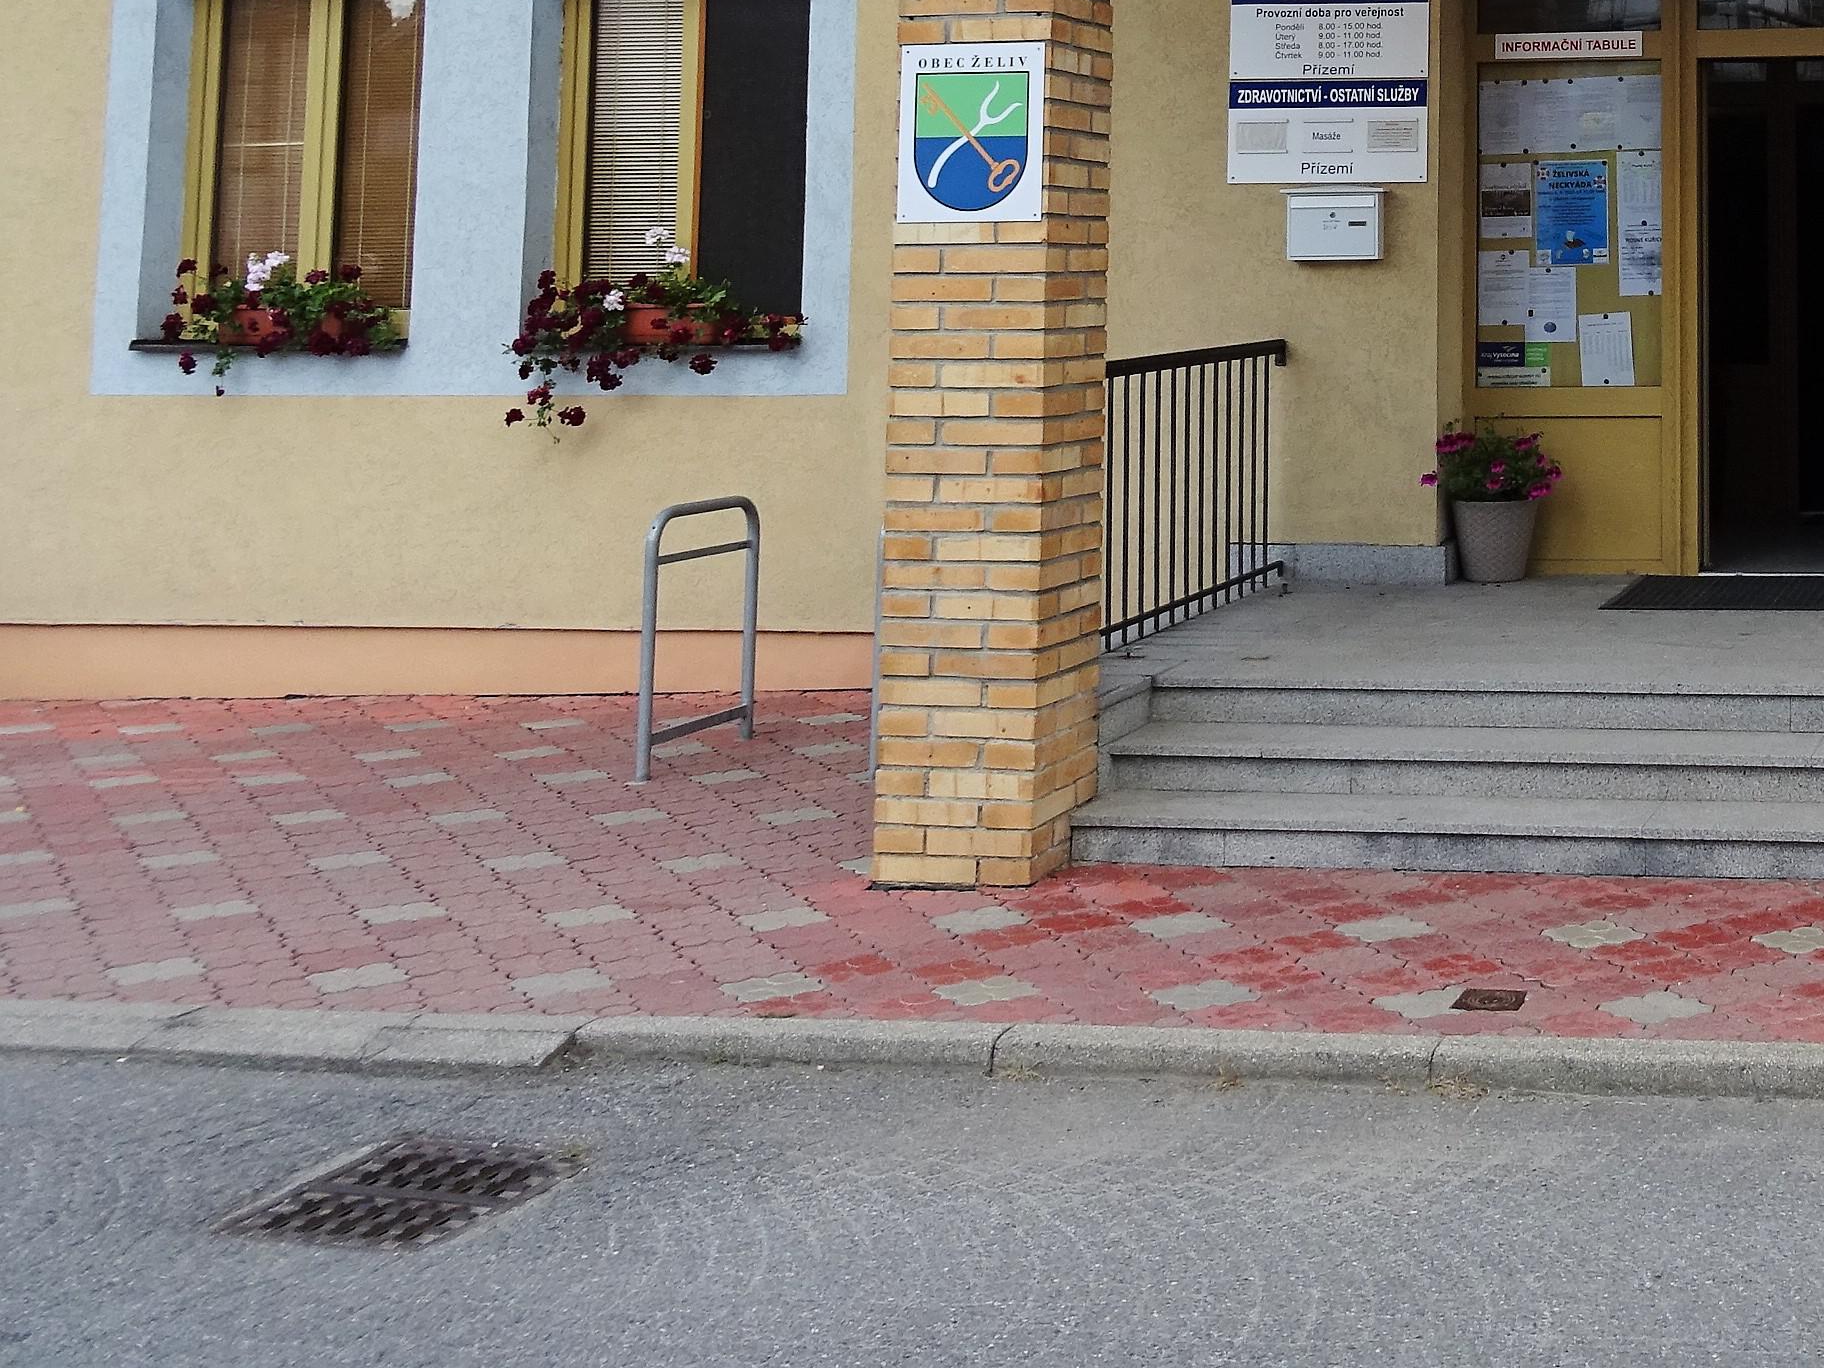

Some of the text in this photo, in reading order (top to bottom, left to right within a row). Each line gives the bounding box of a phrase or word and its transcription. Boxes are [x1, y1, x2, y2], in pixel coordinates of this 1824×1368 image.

[1256, 7, 1404, 20] Provozní doba pro veřejnost
[1275, 42, 1301, 50] Středa
[1501, 39, 1636, 52] INFORMAČNÍ TABULE
[918, 54, 1029, 69] OBEC ŽELIV
[1302, 64, 1355, 75] Přízemí
[1238, 86, 1322, 103] ZDRAVOTNICTVÍ
[1330, 85, 1375, 102] OSTATNÍ
[1377, 85, 1420, 102] SLUŽBY
[1312, 132, 1341, 141] Masáže
[1301, 162, 1353, 174] Přízemí
